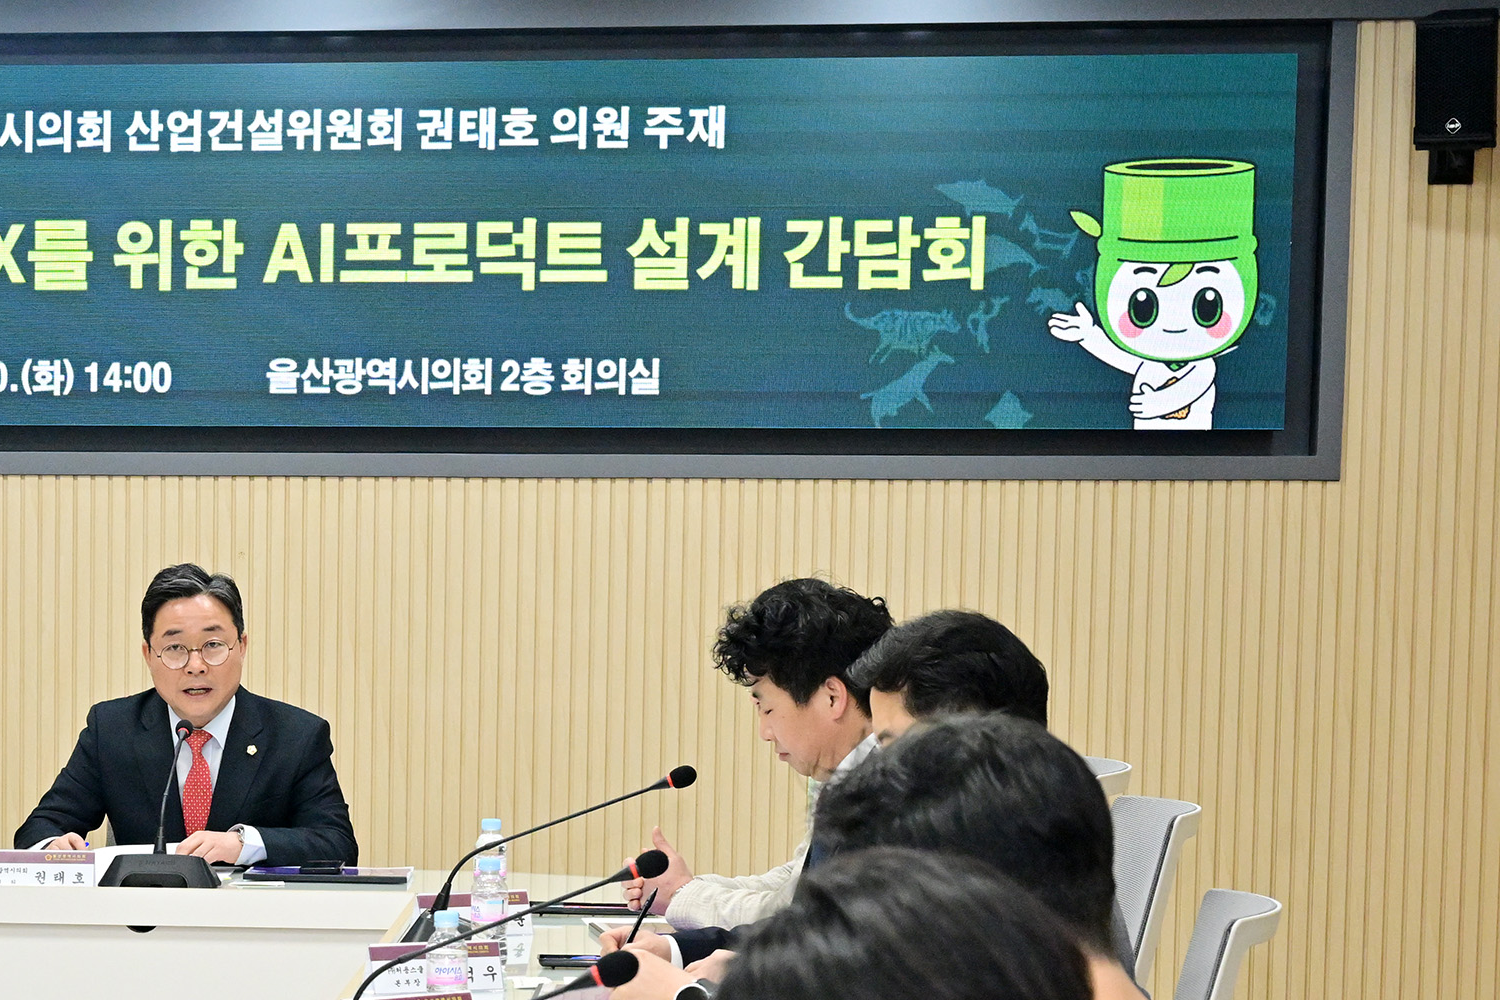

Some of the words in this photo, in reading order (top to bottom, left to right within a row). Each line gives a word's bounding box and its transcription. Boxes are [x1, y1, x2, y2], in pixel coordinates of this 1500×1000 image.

[125, 108, 403, 153] 산업건설위원회
[417, 107, 539, 151] 권태호
[550, 106, 630, 150] 의원
[644, 105, 726, 150] 주재
[114, 219, 244, 291] 위한
[263, 218, 608, 291] AI프로덕트
[626, 217, 761, 290] 설계
[784, 216, 987, 290] 간담회
[85, 362, 172, 393] 14:00
[266, 357, 493, 395] 울산광역시의회
[501, 358, 555, 395] 2층
[561, 357, 661, 395] 회의실
[434, 966, 463, 975] 아이시스
